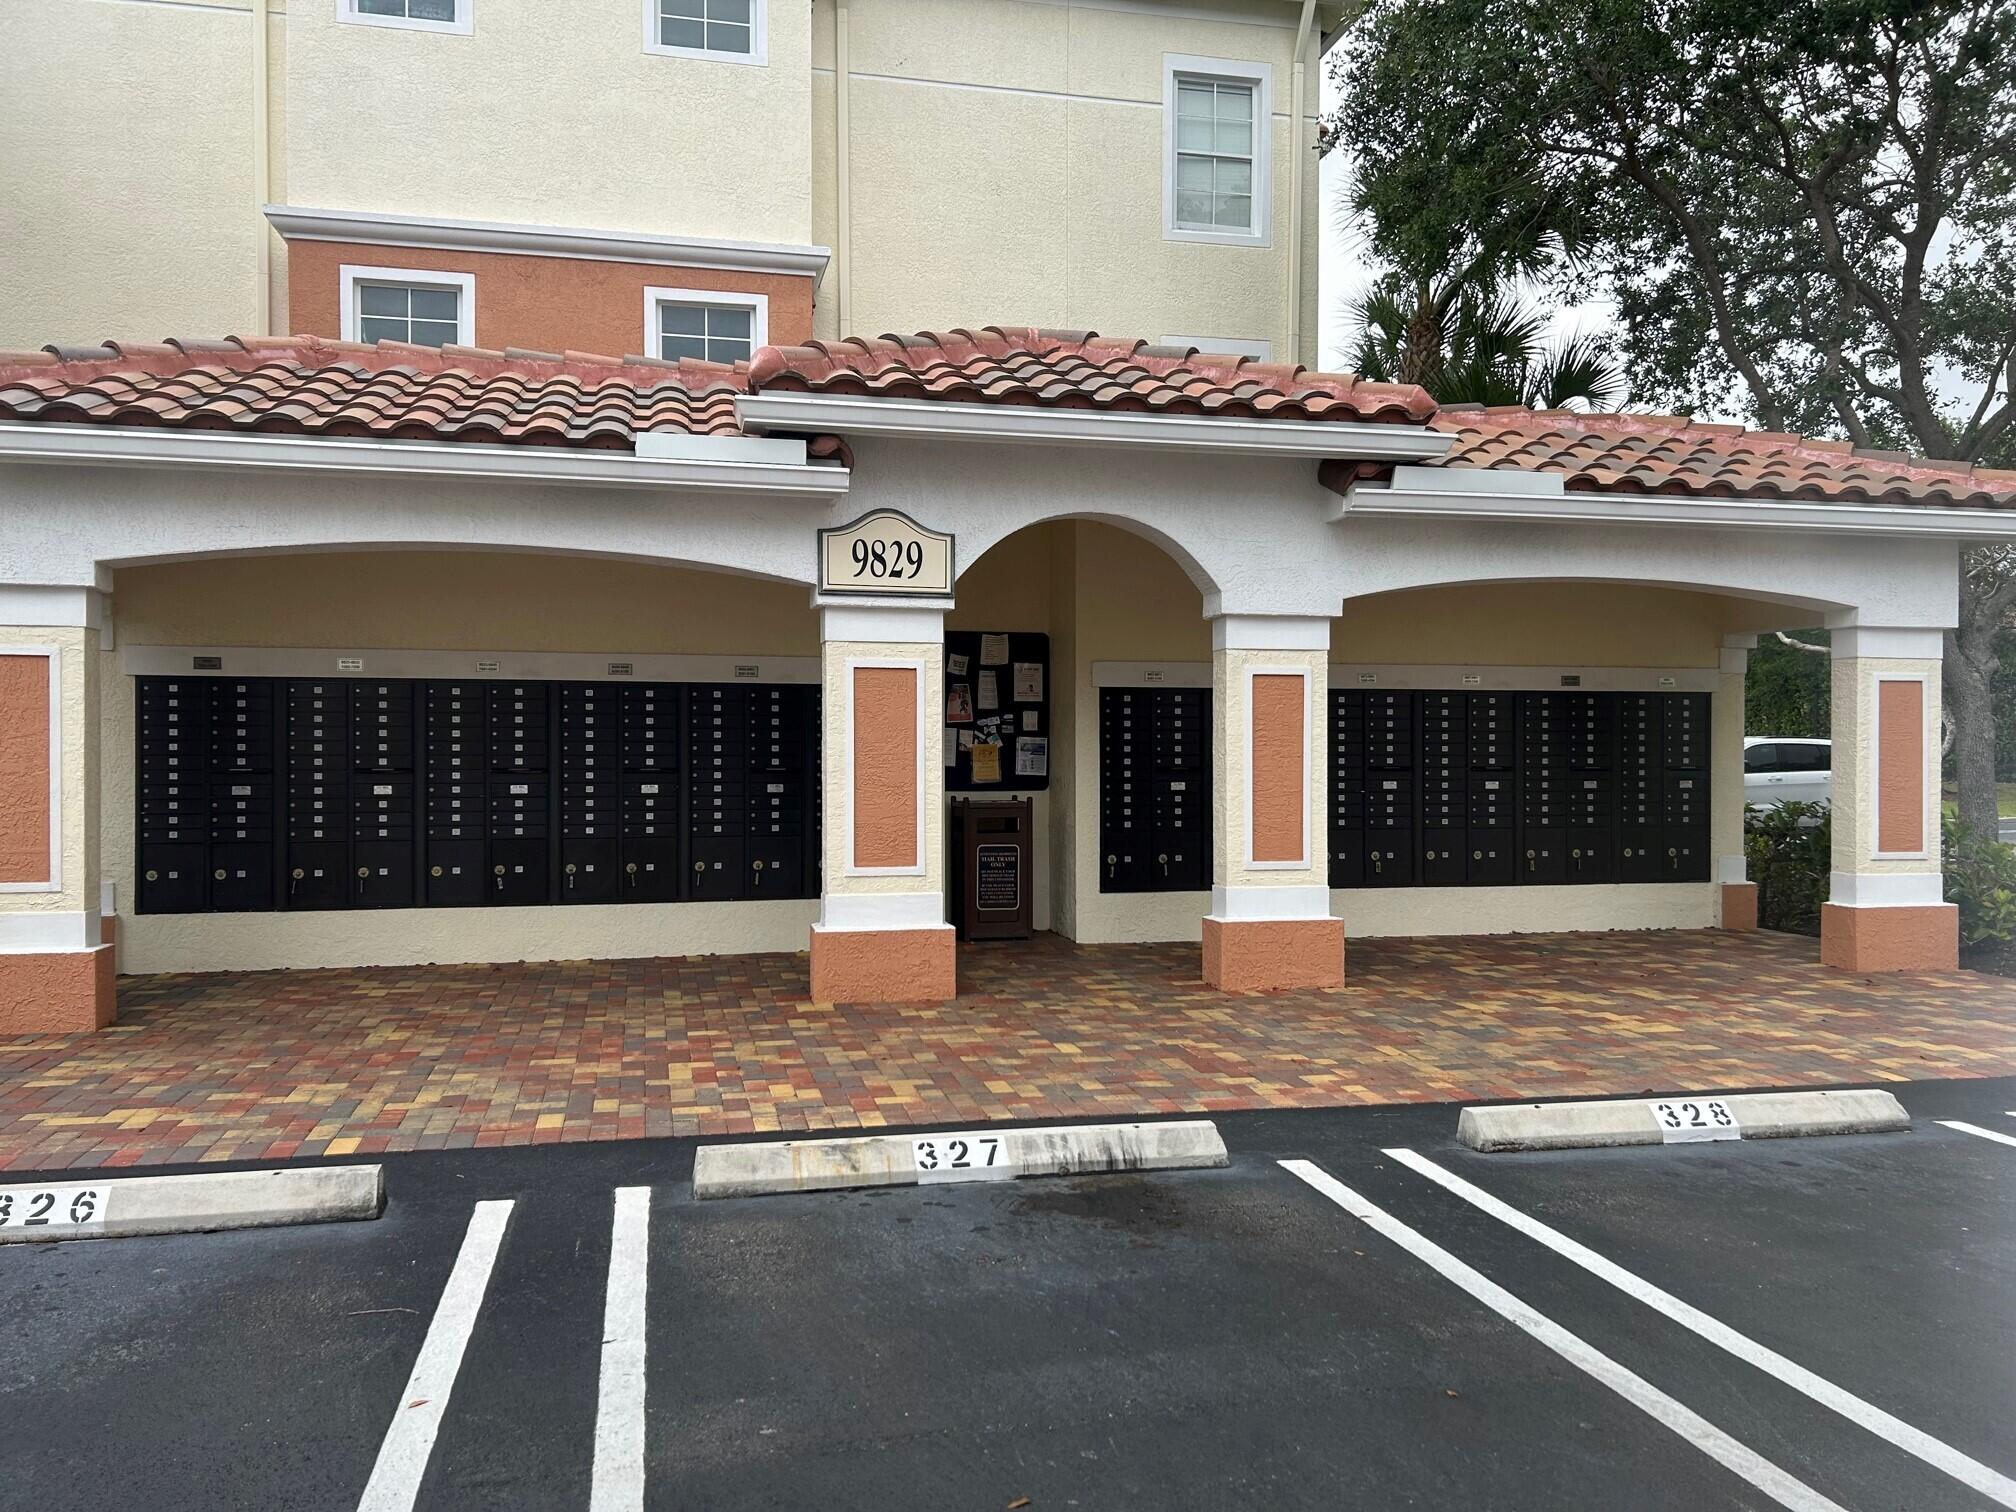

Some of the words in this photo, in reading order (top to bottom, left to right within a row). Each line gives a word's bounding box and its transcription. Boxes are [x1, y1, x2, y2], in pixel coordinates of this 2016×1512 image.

[852, 538, 923, 579] 9829
[1658, 1102, 1731, 1128] 328
[918, 1138, 998, 1170] 327
